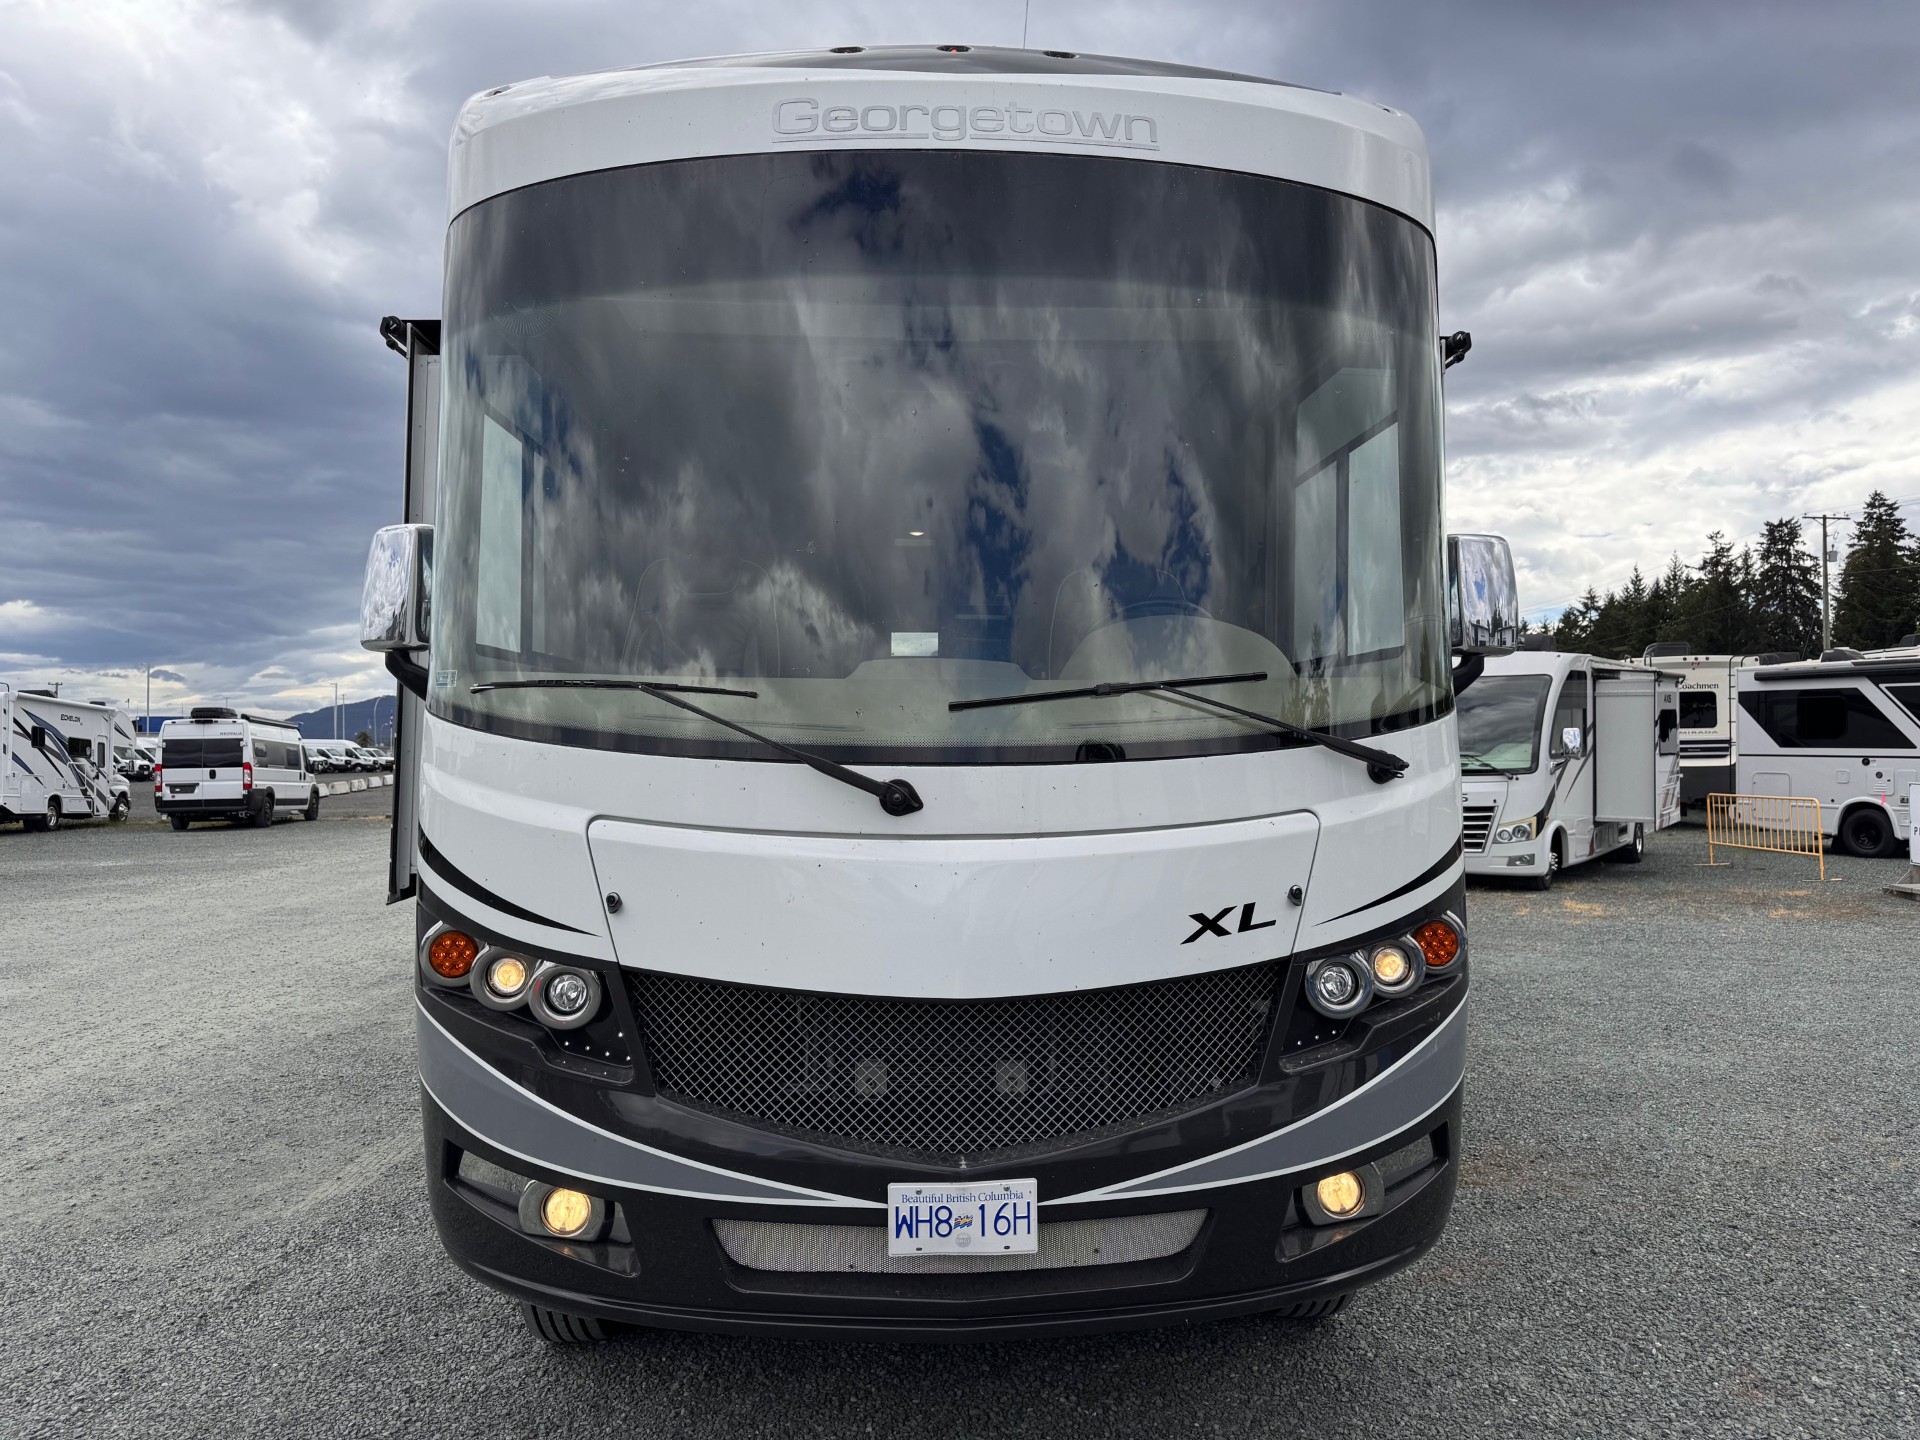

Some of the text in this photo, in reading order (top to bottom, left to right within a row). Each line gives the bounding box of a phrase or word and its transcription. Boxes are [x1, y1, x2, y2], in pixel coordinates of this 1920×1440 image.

[771, 97, 1158, 143] Georgetown
[1679, 682, 1719, 690] oachmen
[60, 713, 81, 723] ECHELON
[1179, 901, 1277, 945] XL
[901, 1191, 1024, 1203] Beautiful British Columbia
[895, 1201, 1031, 1239] WH8 16H
